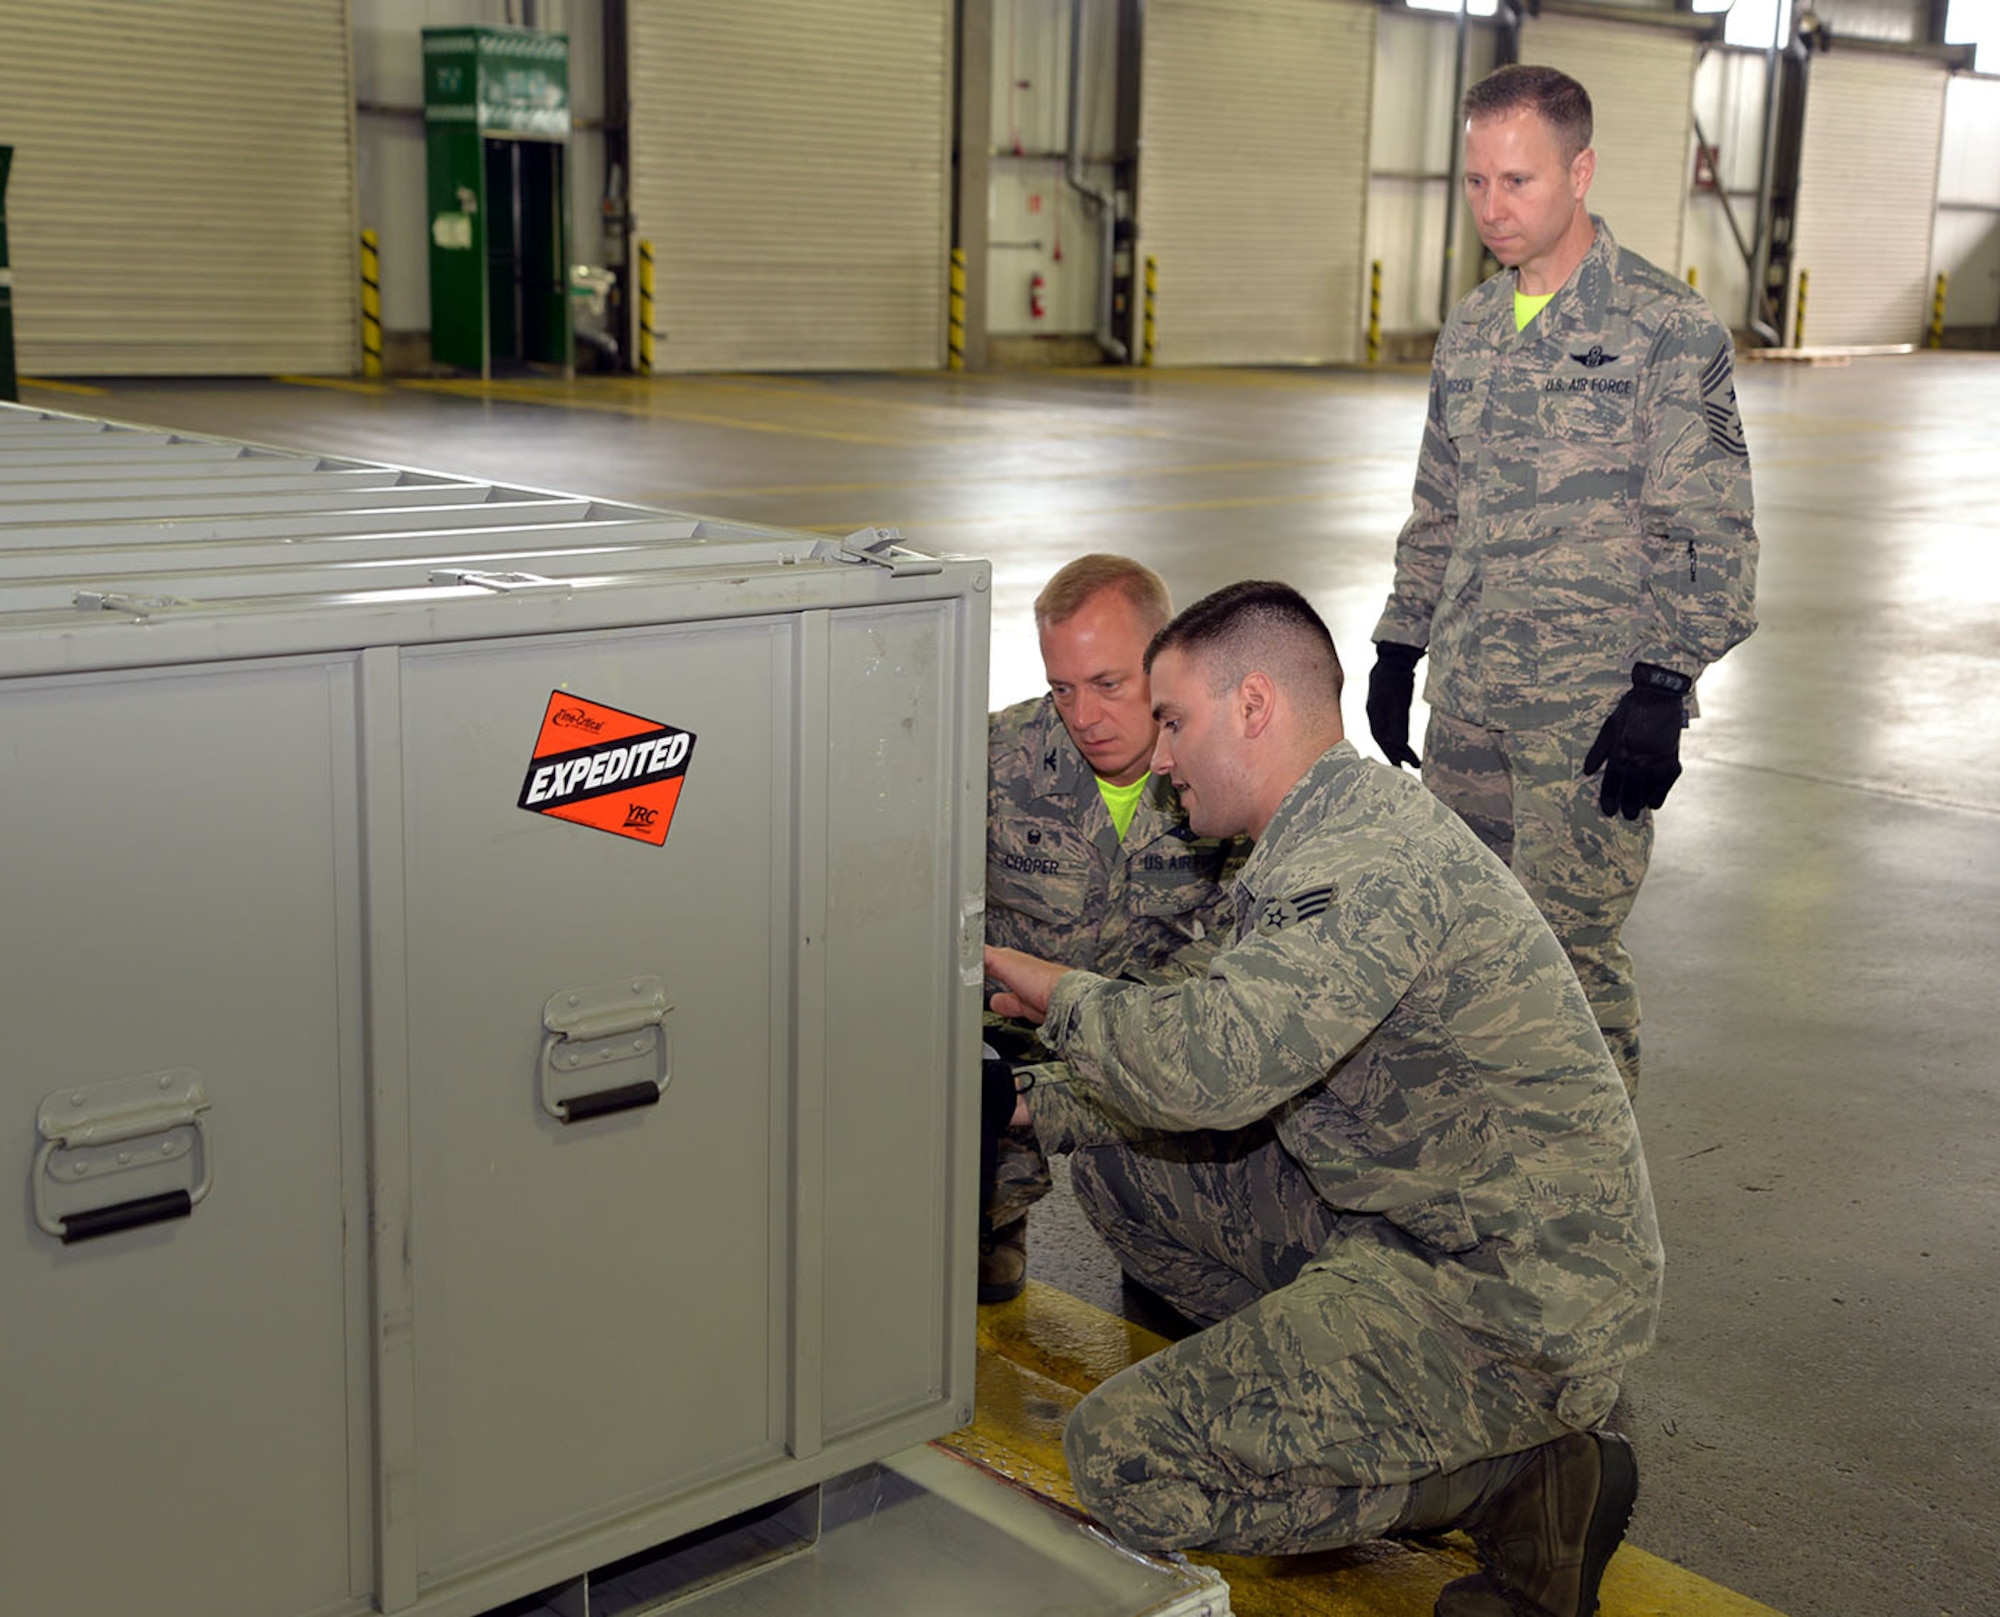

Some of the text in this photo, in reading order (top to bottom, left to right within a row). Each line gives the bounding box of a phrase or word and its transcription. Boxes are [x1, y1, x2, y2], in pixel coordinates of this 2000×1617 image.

[1545, 378, 1633, 395] U.S. AIR FORCE
[525, 732, 690, 805] EXPEDITED
[628, 803, 659, 825] YRC
[1005, 854, 1060, 876] COOPER
[1144, 854, 1163, 871] US
[1168, 855, 1192, 871] AIR
